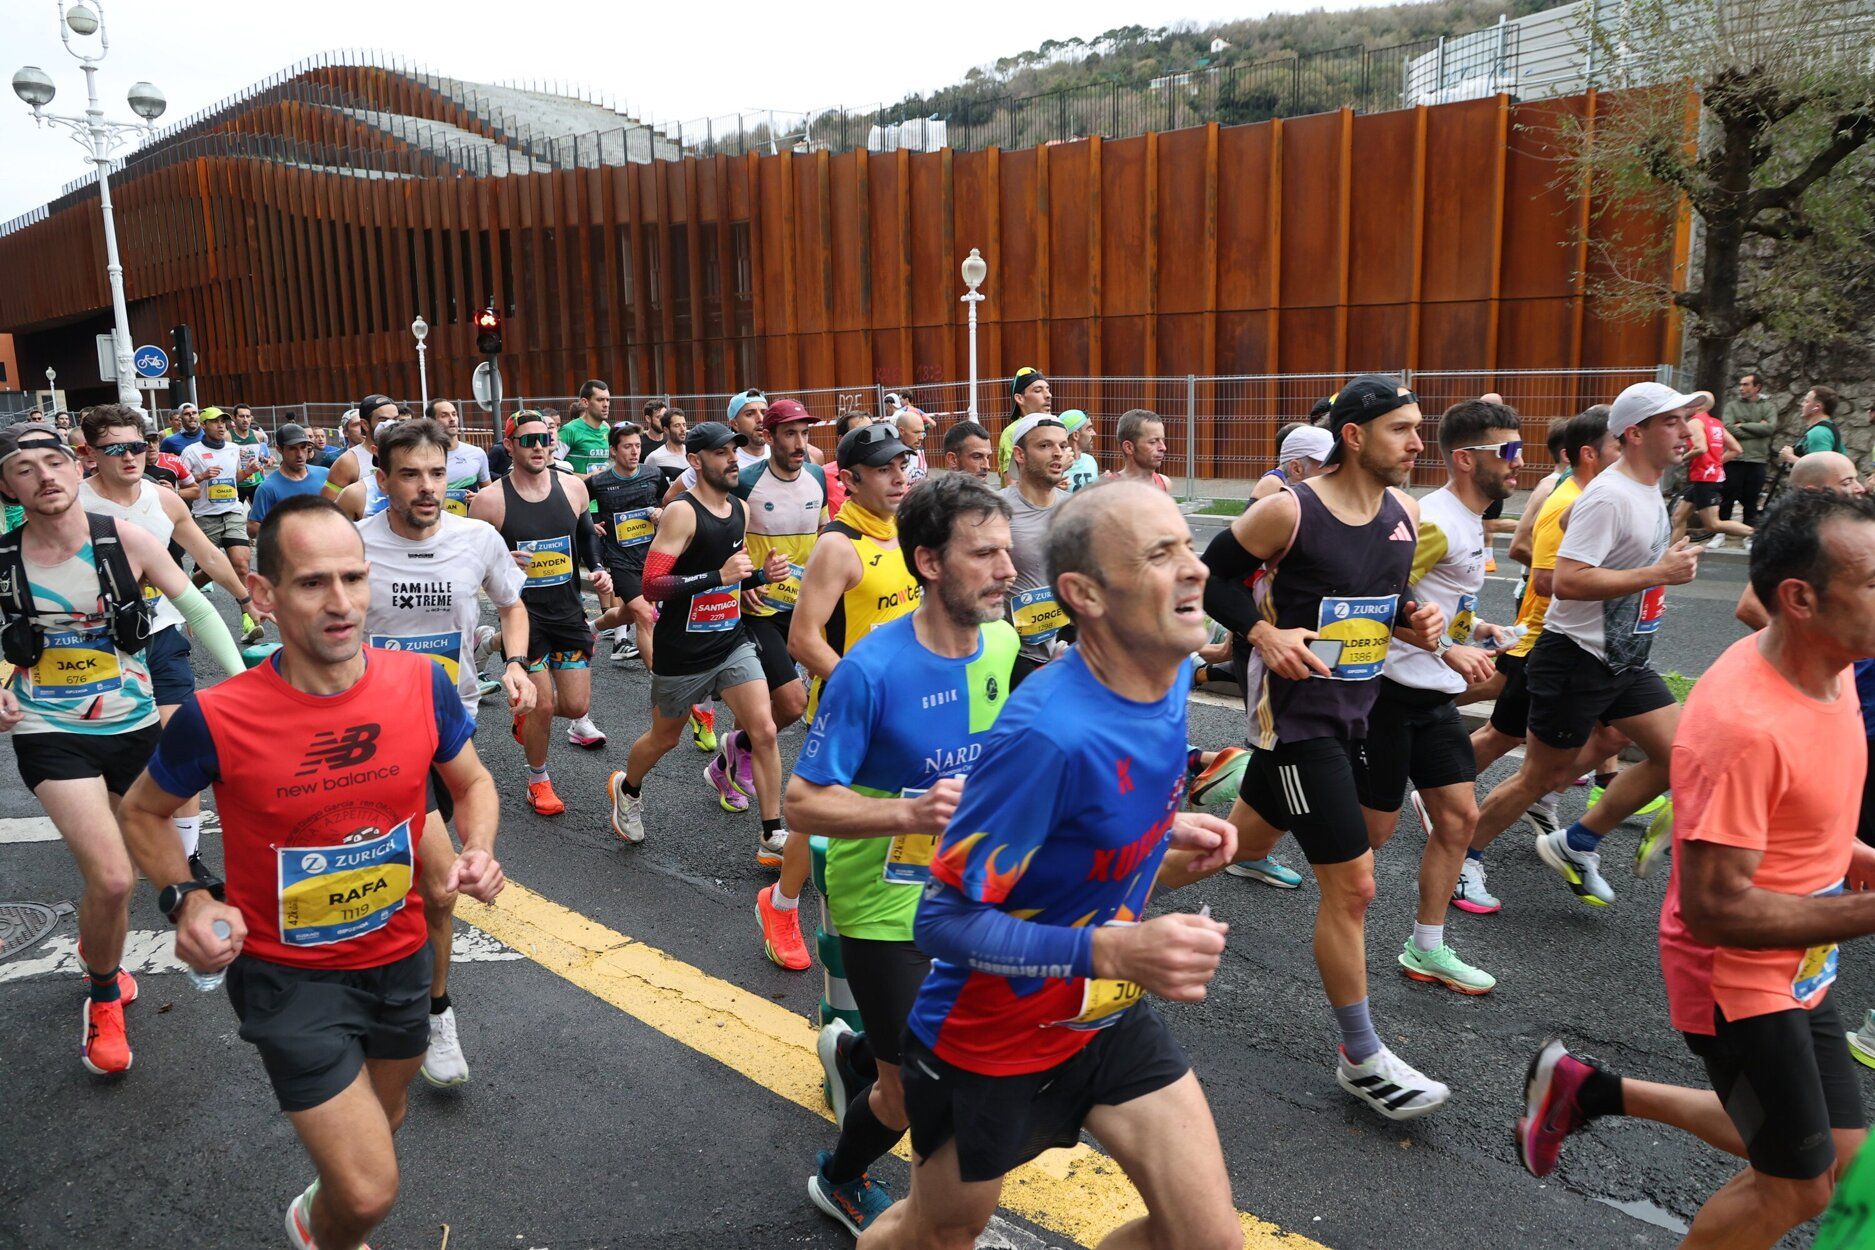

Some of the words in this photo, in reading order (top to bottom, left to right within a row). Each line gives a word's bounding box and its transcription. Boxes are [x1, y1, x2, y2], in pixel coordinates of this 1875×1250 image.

[626, 523, 647, 532] DAVID
[538, 541, 563, 550] ZURICH
[531, 558, 566, 569] JAYDEN
[392, 582, 452, 594] CAMILLE
[392, 594, 452, 609] EXTREME
[698, 600, 737, 612] SANTIAGO
[1352, 604, 1390, 614] ZURICH
[1031, 609, 1062, 624] JORGE
[406, 639, 448, 651] ZURICH
[1349, 652, 1372, 662] 1386
[57, 658, 97, 671] JACK
[66, 675, 87, 684] 676
[276, 783, 317, 798] new
[323, 765, 400, 791] balance
[335, 838, 396, 867] ZURICH
[328, 878, 388, 906] RAFA
[341, 903, 370, 920] 1119
